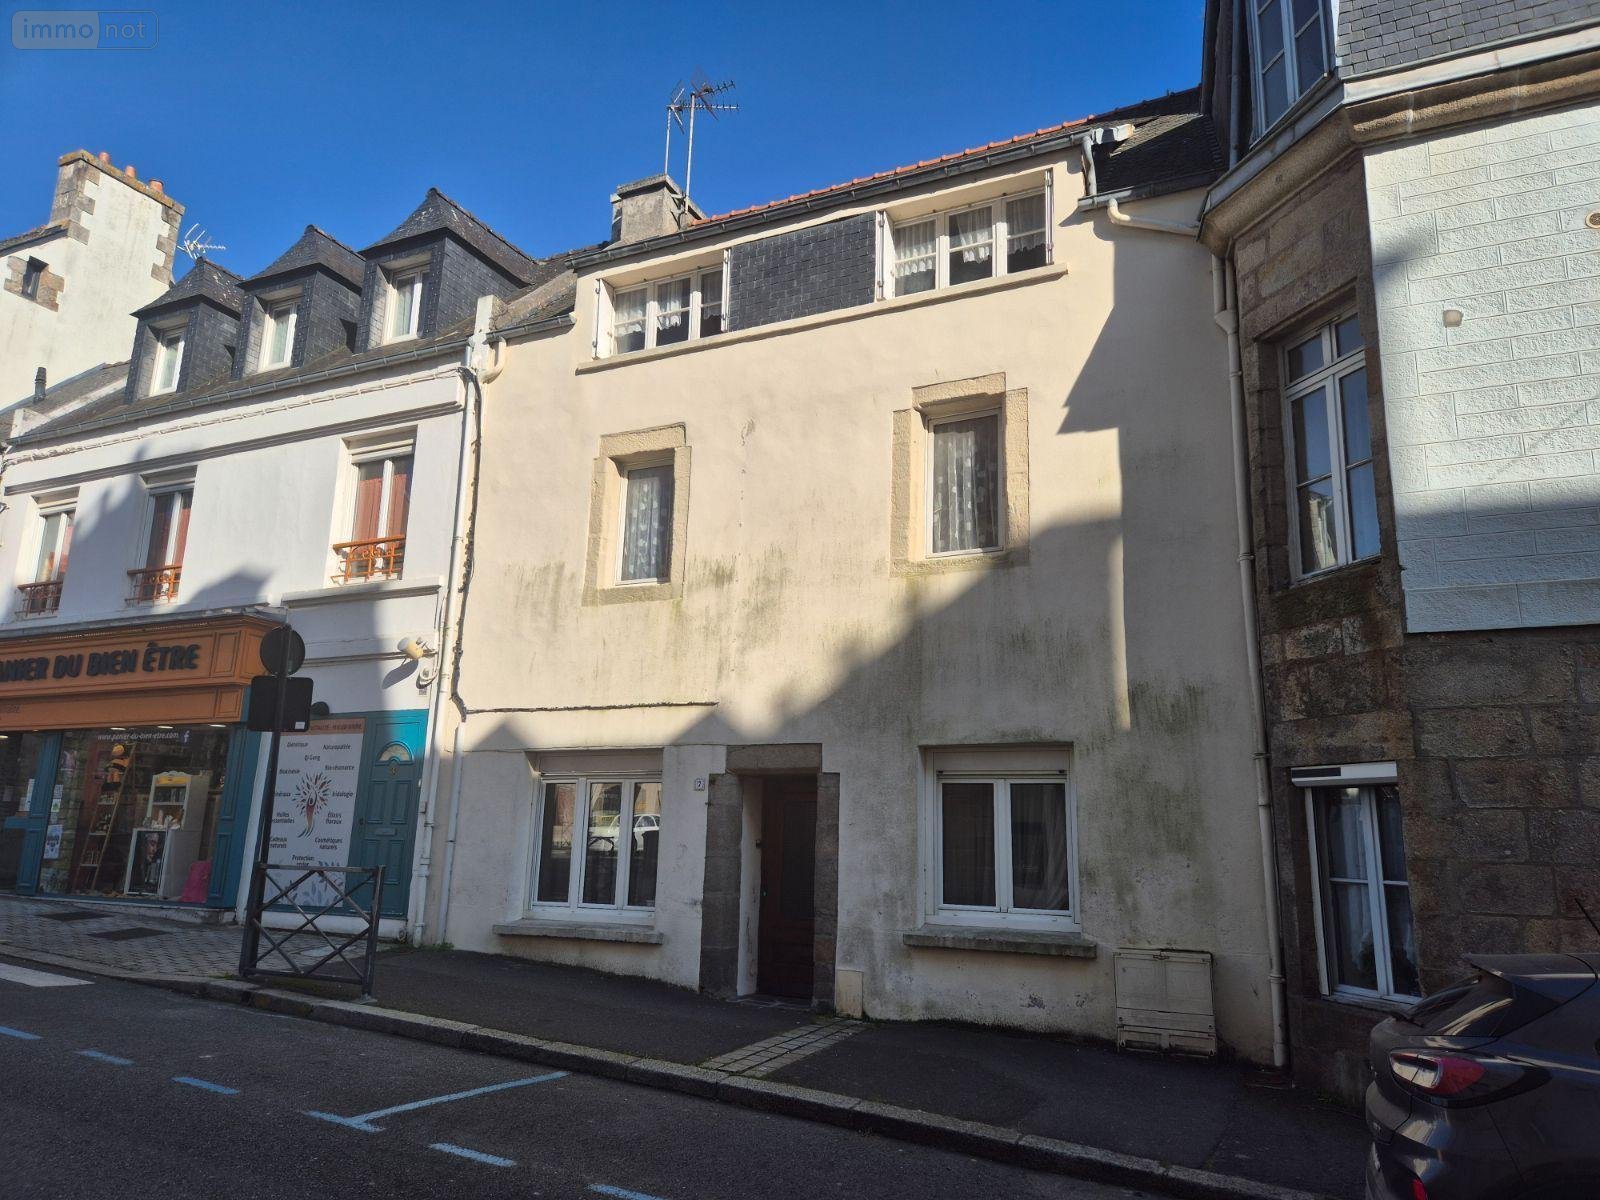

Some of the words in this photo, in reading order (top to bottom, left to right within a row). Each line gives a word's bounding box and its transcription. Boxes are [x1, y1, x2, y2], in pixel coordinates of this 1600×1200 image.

[53, 654, 83, 679] DU
[87, 649, 139, 677] BIEN
[142, 640, 201, 673] ÊTRE
